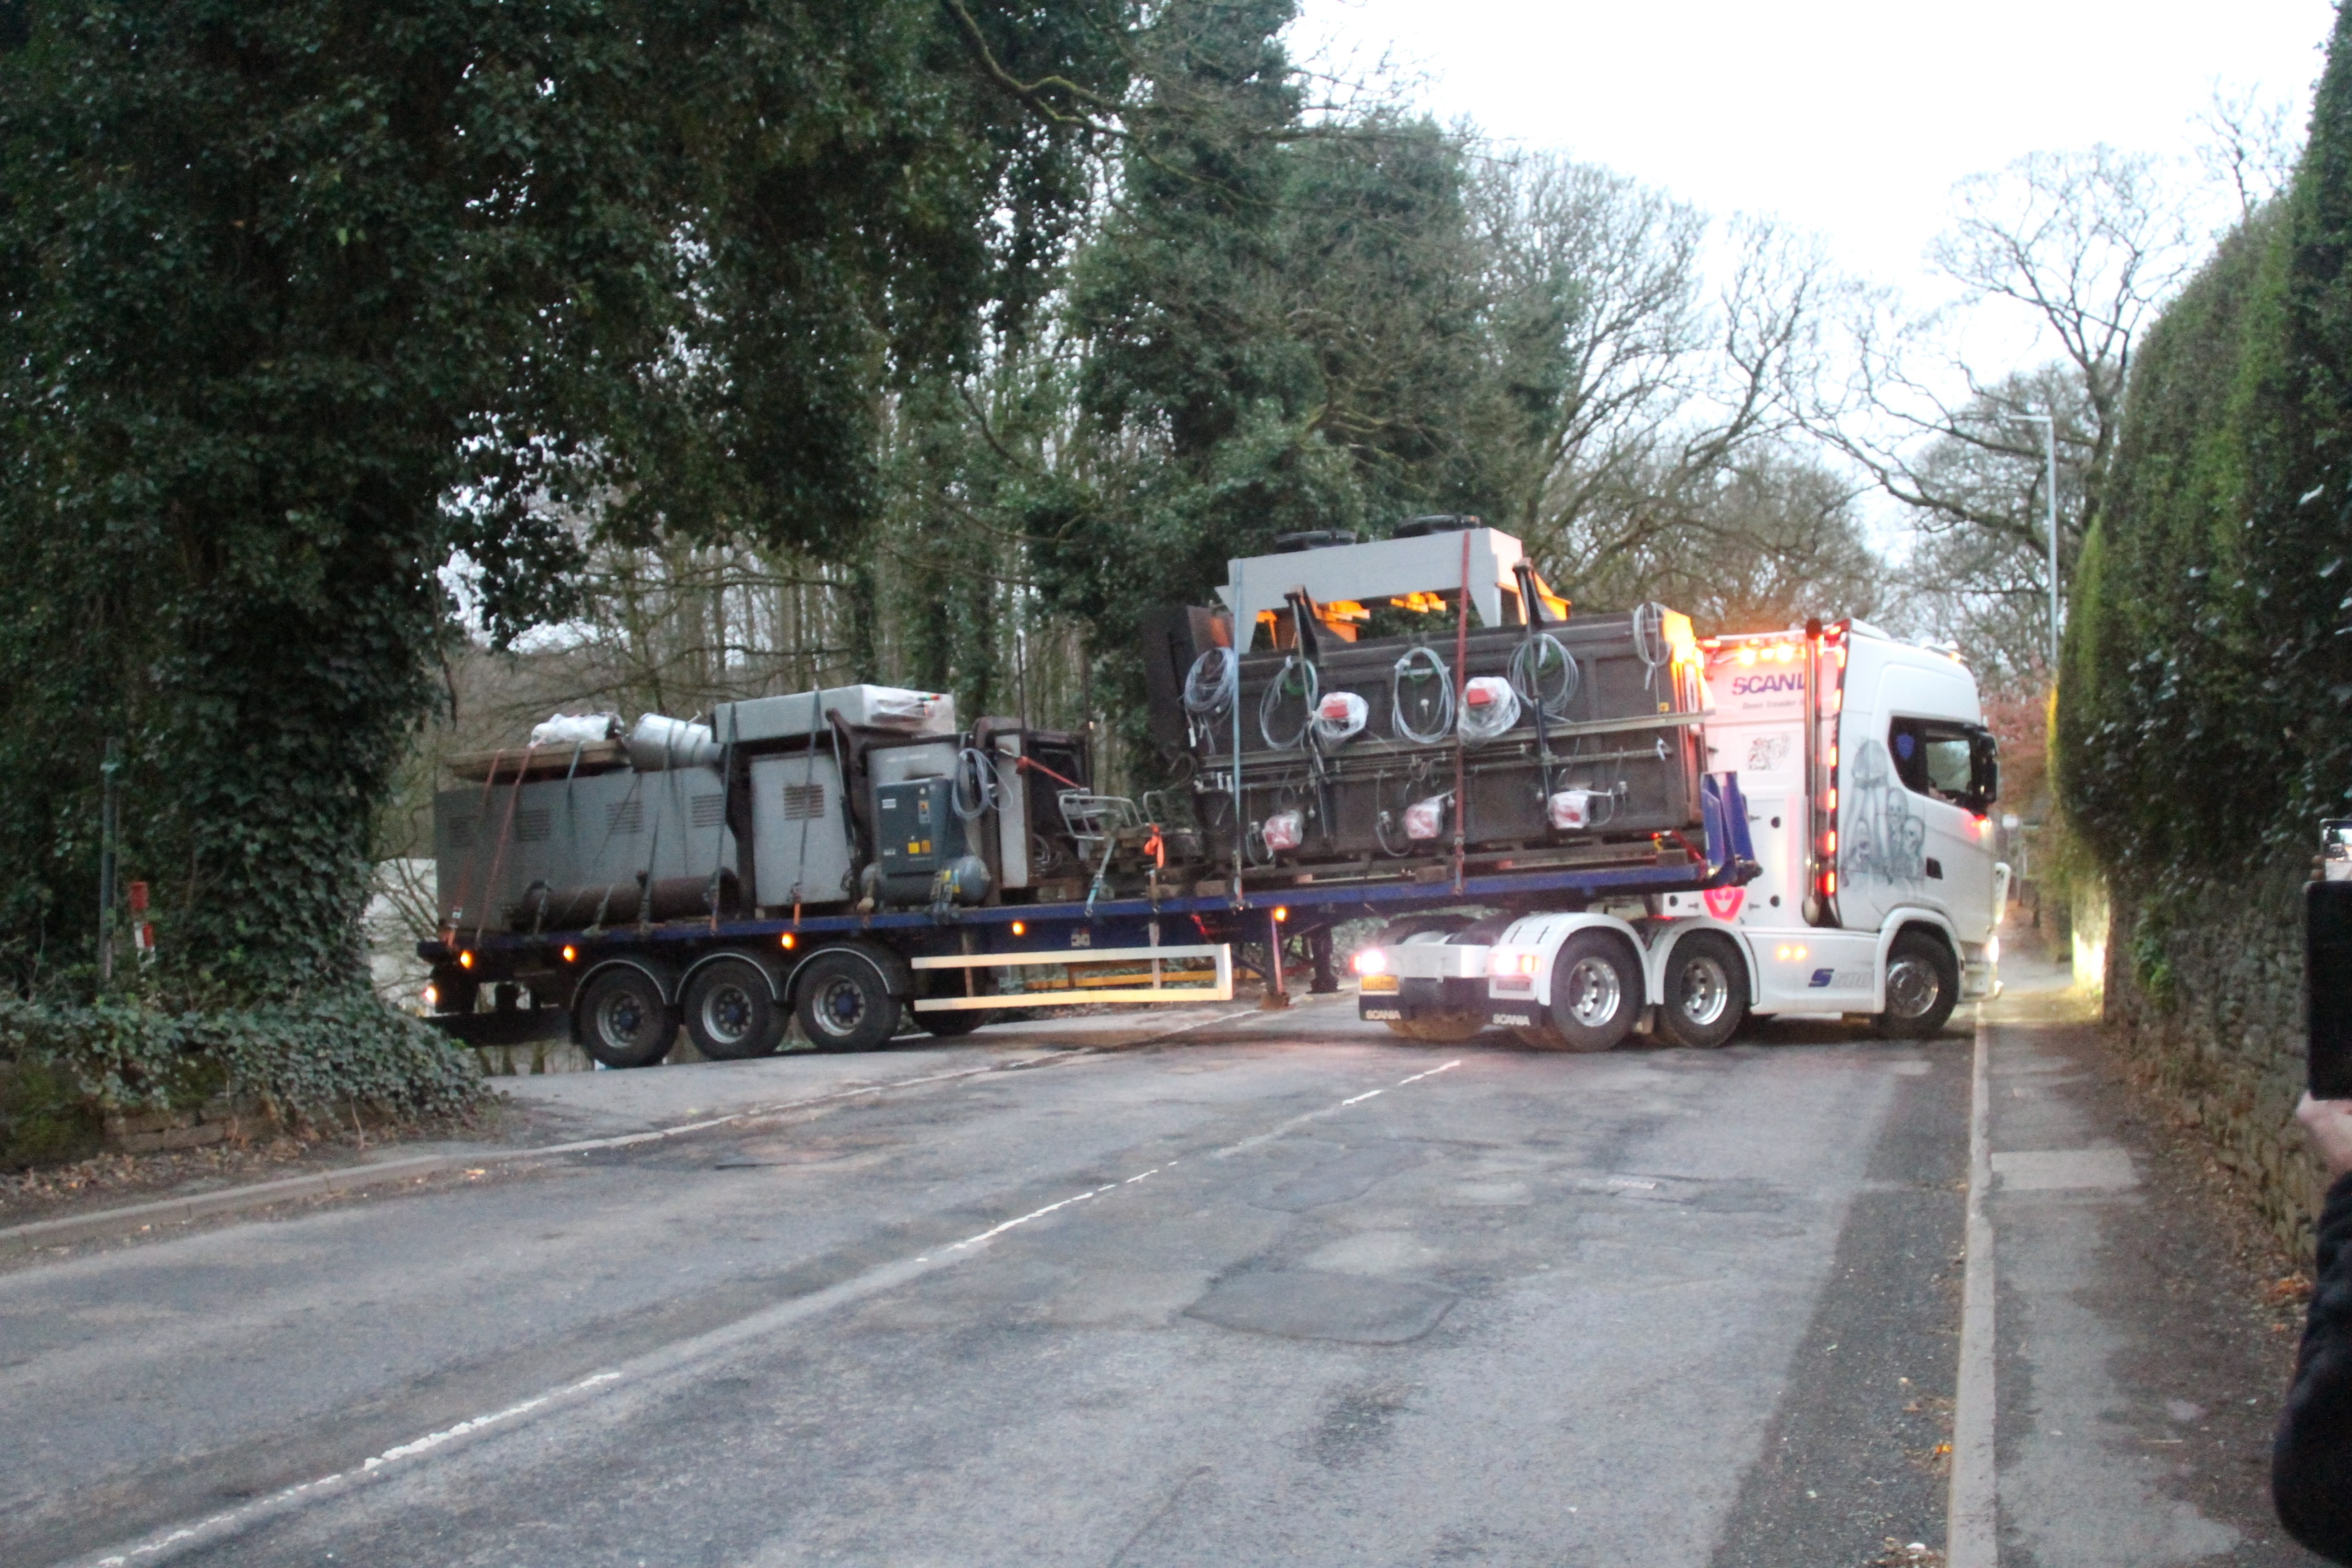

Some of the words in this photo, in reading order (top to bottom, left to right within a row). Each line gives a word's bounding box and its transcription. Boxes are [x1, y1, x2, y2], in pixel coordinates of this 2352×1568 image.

[1732, 673, 1804, 695] SCANI
[1366, 1009, 1401, 1019] SCANIA
[1493, 1014, 1530, 1026] SCANIA
